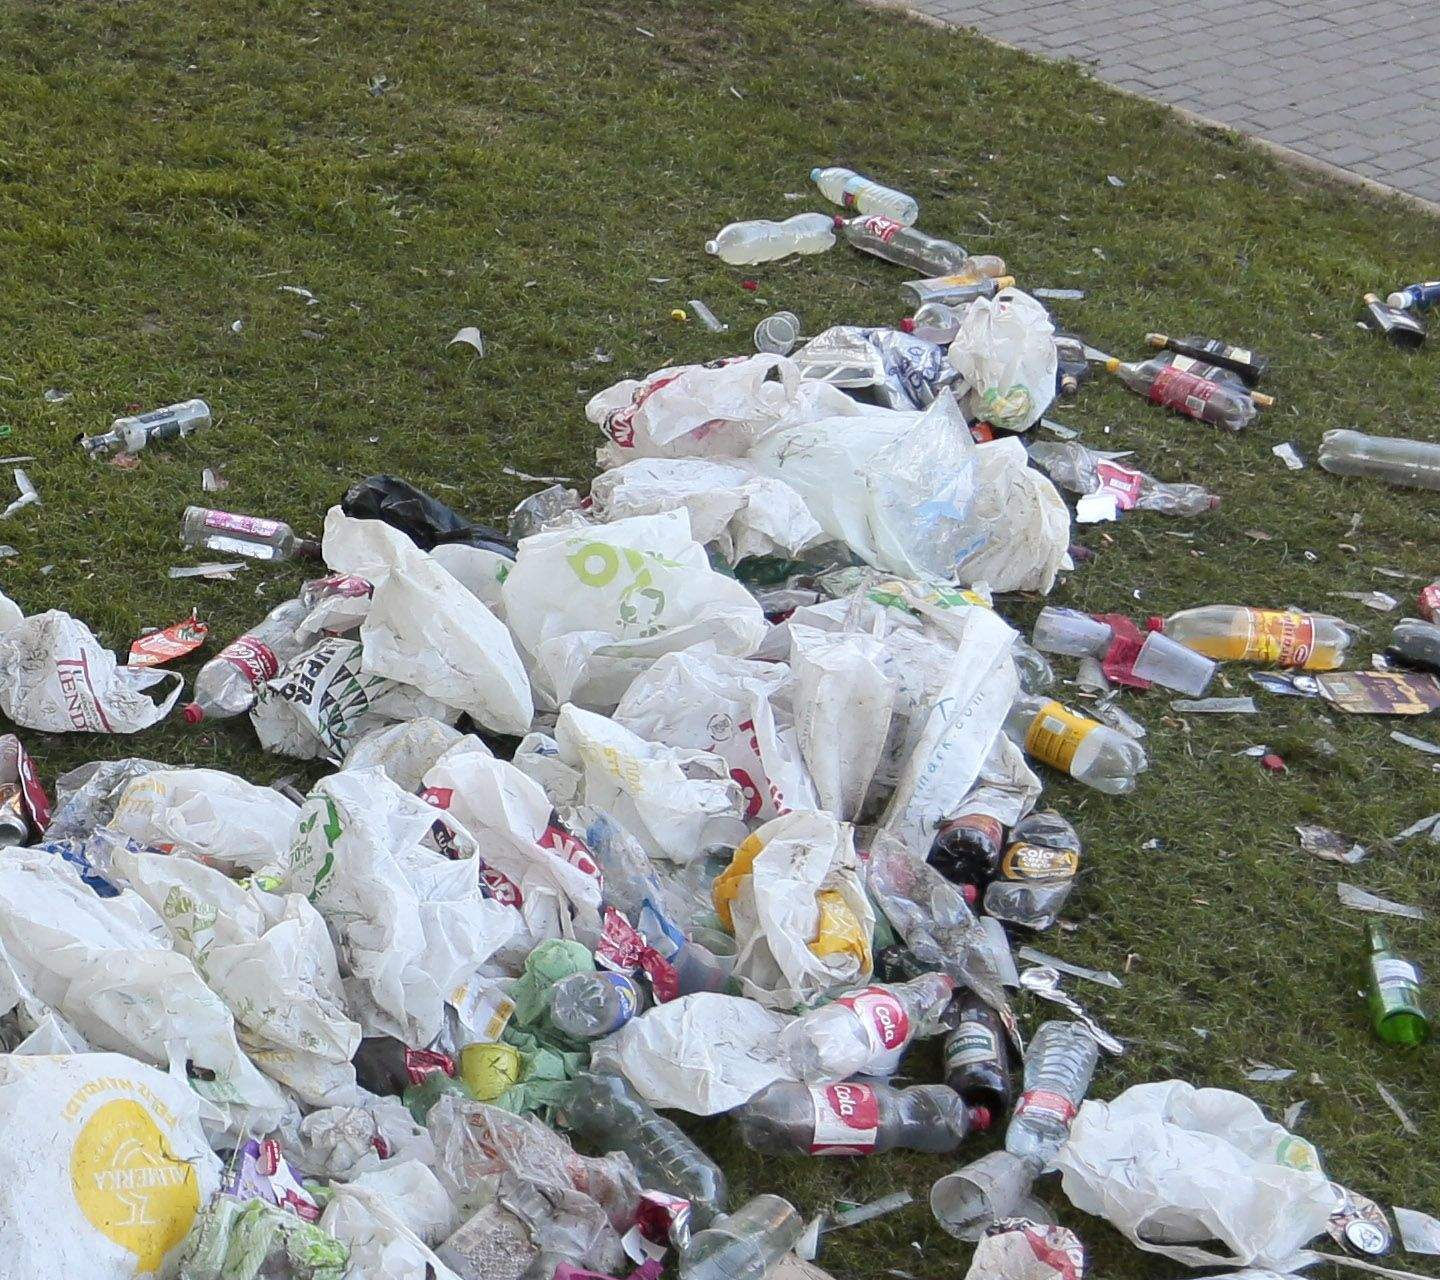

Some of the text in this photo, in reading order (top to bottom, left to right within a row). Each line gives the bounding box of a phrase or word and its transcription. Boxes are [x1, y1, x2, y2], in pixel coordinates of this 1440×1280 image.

[293, 649, 337, 706] UPER
[875, 1005, 896, 1043] Cola
[833, 1084, 857, 1116] Cola
